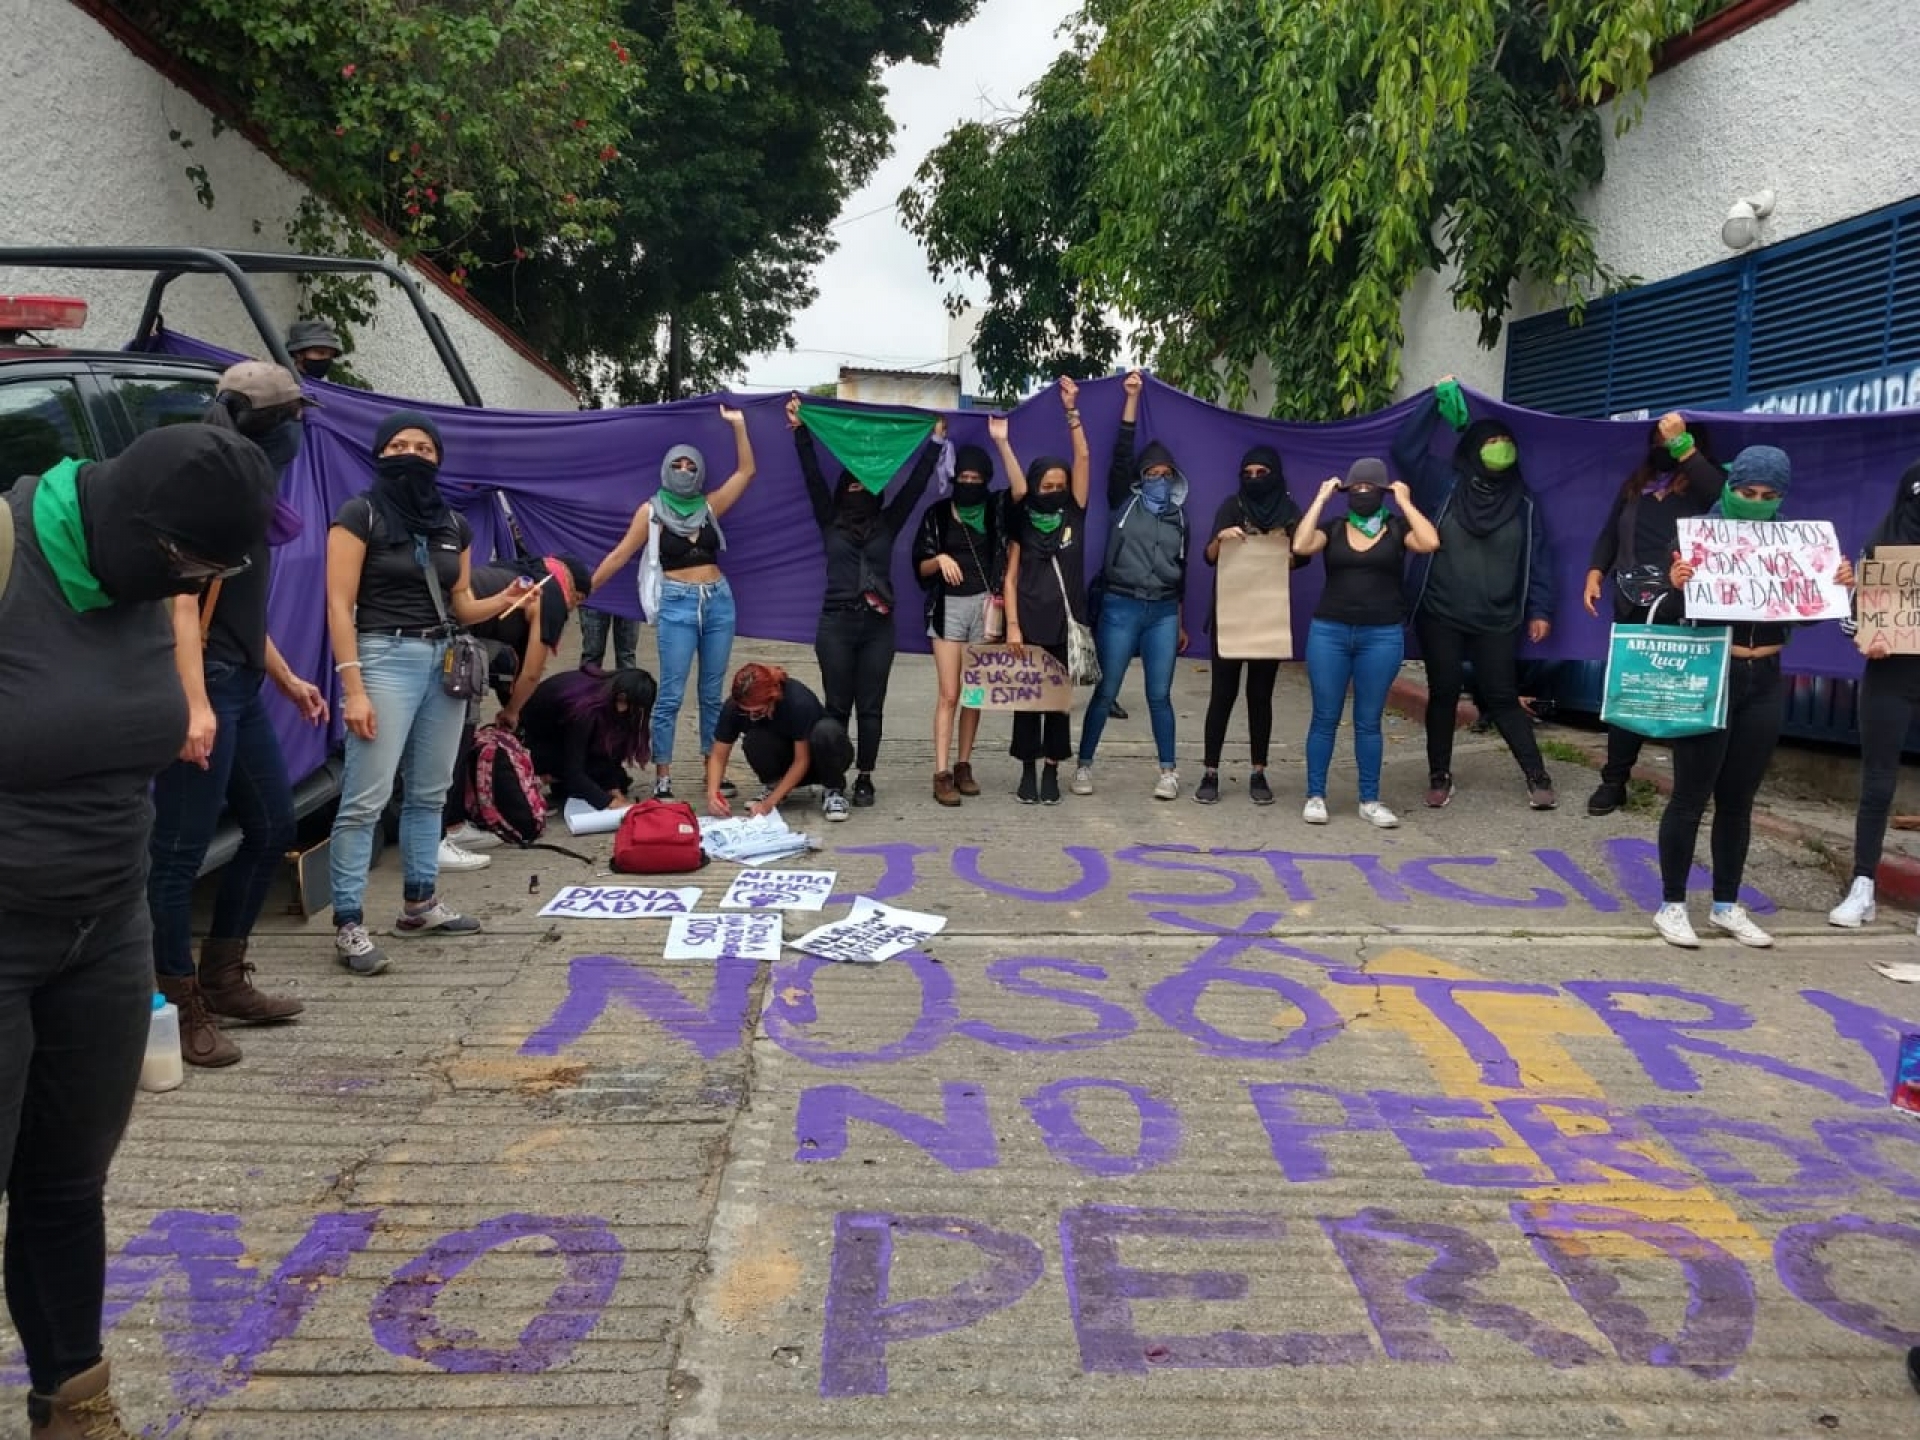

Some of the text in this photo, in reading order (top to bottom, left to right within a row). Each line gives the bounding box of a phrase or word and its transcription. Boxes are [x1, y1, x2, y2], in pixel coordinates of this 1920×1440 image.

[1863, 561, 1892, 586] EL
[1863, 588, 1892, 610] NO
[1862, 612, 1889, 628] ME
[1626, 638, 1711, 655] ABARROTES
[967, 646, 1015, 668] SOMOS
[964, 671, 981, 685] DE
[986, 670, 1011, 684] LAS
[1014, 670, 1042, 685] QUE
[565, 887, 681, 902] DIGNA
[822, 838, 1779, 934] JUSTICIA
[550, 899, 688, 914] RABIA
[797, 1078, 1180, 1176] NO
